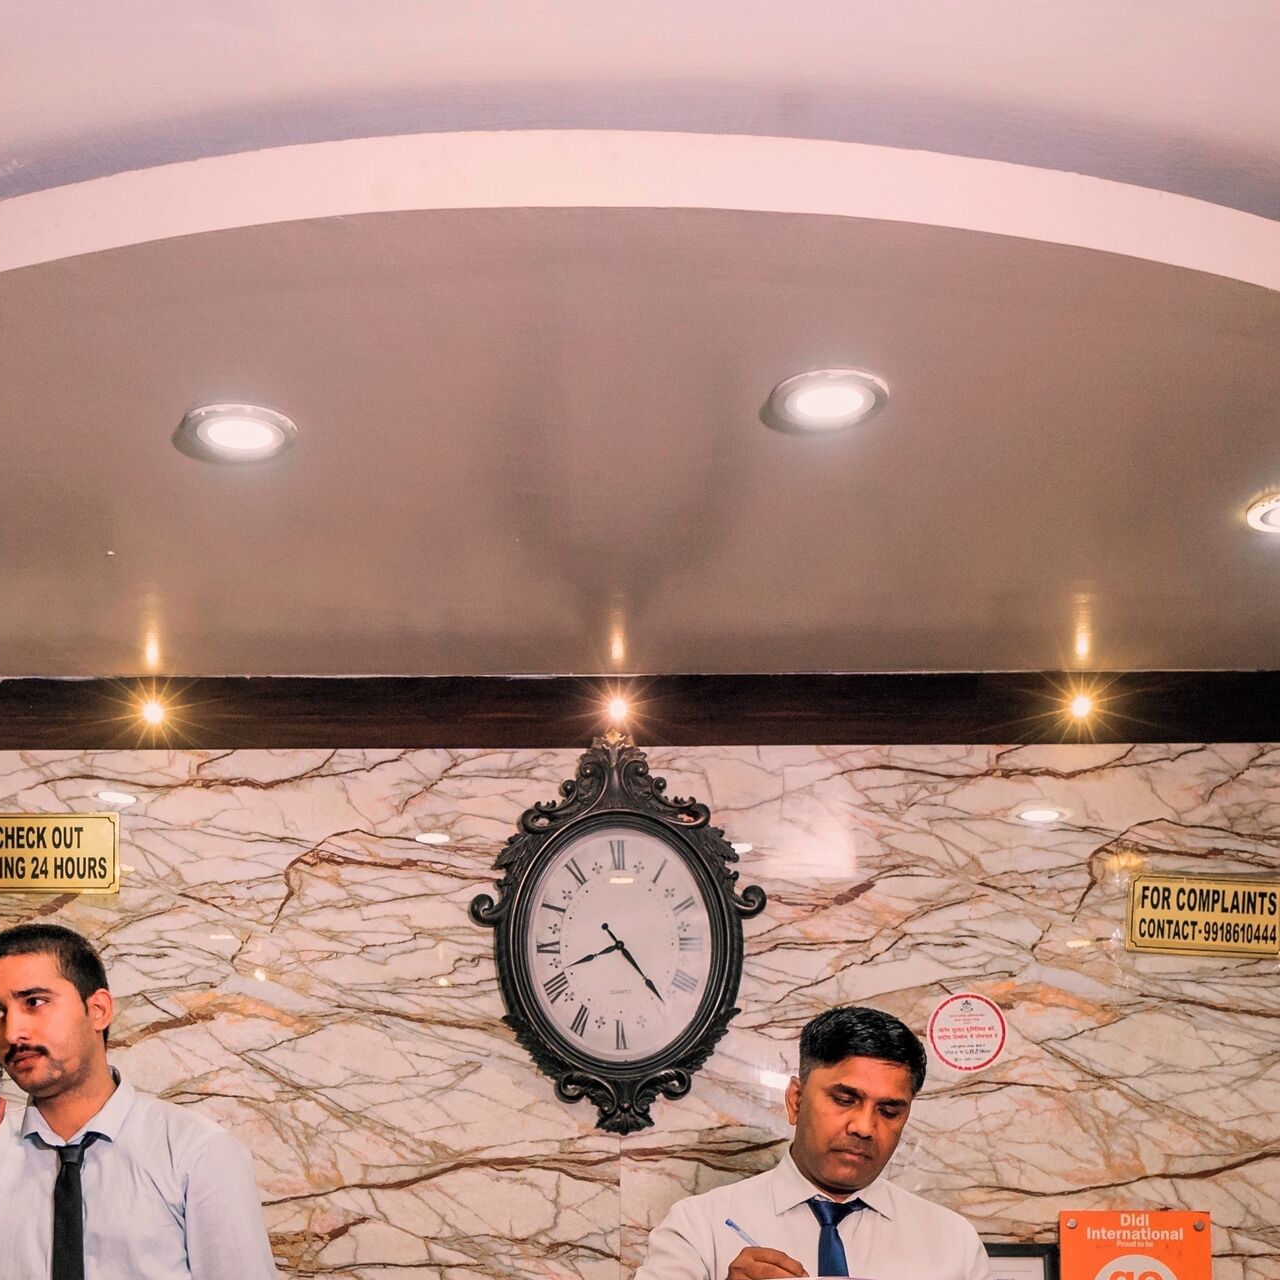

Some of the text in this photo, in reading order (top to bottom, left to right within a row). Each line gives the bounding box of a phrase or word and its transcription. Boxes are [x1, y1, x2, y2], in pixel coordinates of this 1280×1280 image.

[52, 826, 83, 849] OUT
[31, 857, 48, 879] 24
[54, 856, 107, 879] HOURS
[1141, 886, 1277, 916] FOR COMPLAINTS
[1120, 1213, 1149, 1227] Didi
[1086, 1227, 1184, 1241] International
[1116, 1240, 1154, 1248] Proud to be
